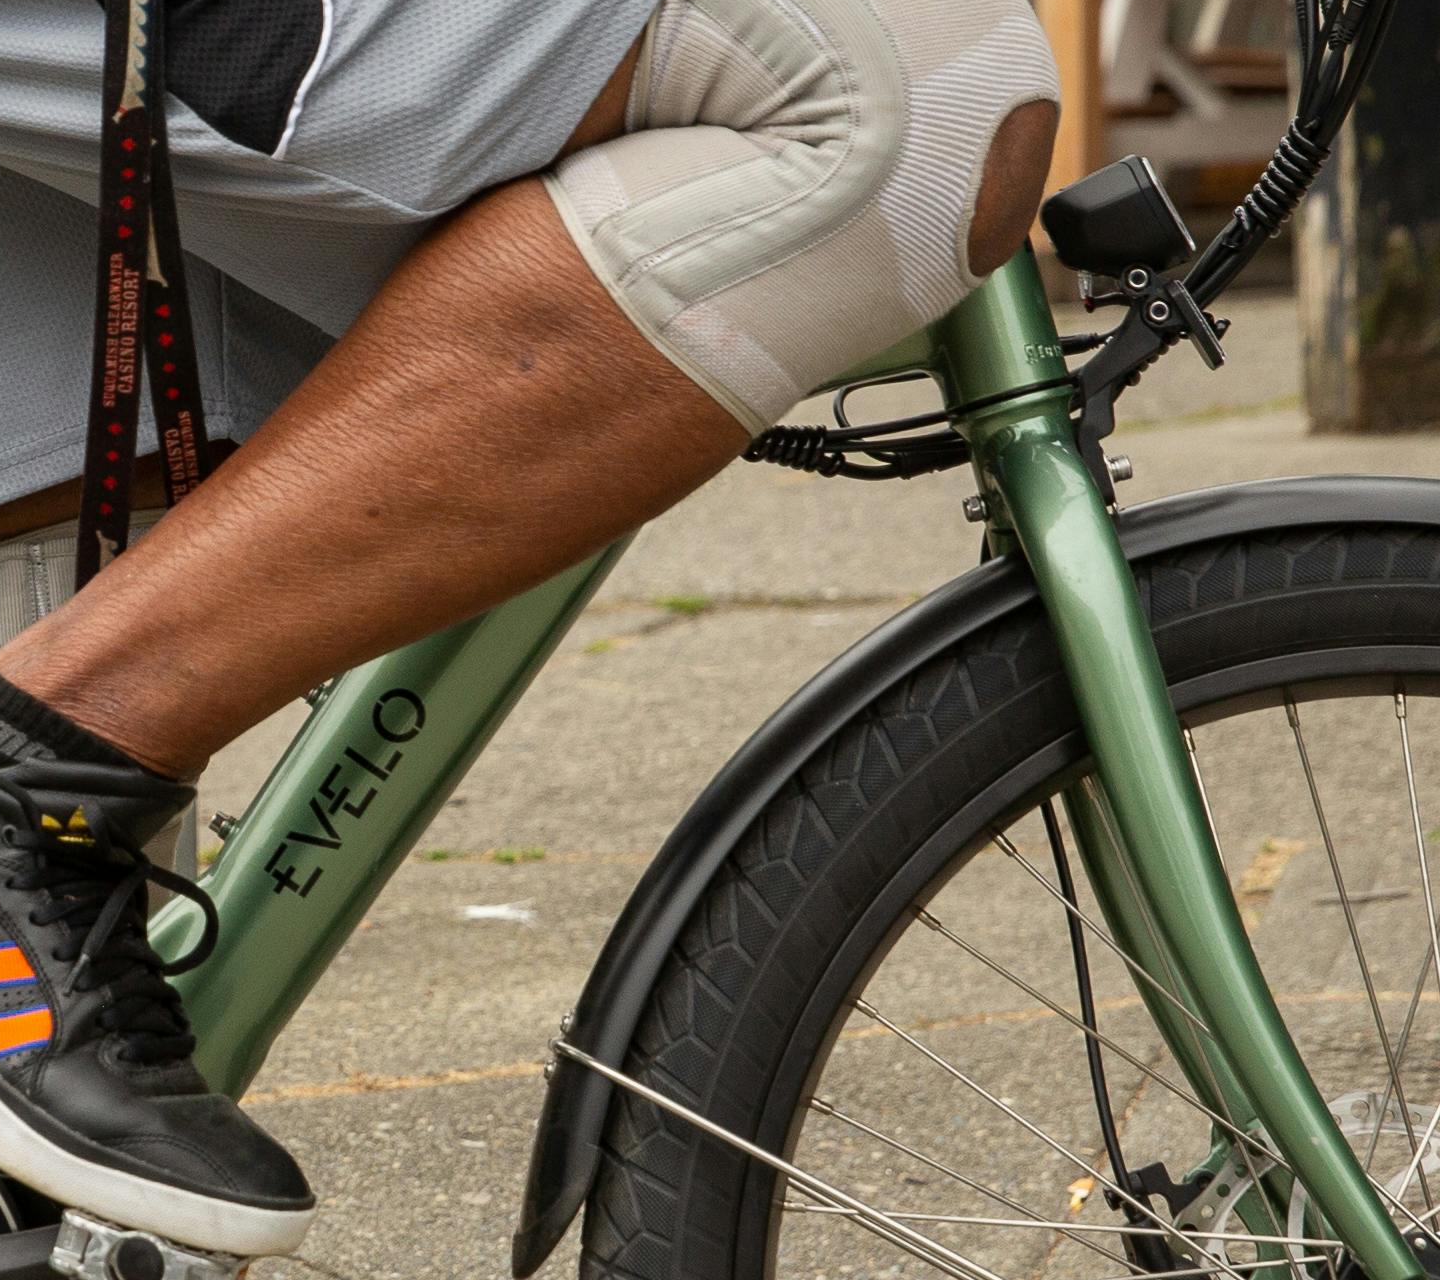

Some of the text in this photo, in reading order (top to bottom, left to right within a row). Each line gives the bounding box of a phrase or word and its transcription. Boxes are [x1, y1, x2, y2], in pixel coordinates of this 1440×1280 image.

[103, 252, 124, 408] SUQUAMISH CLEARWATER
[118, 269, 140, 394] CASINO RESORT
[264, 687, 426, 898] EVELO
